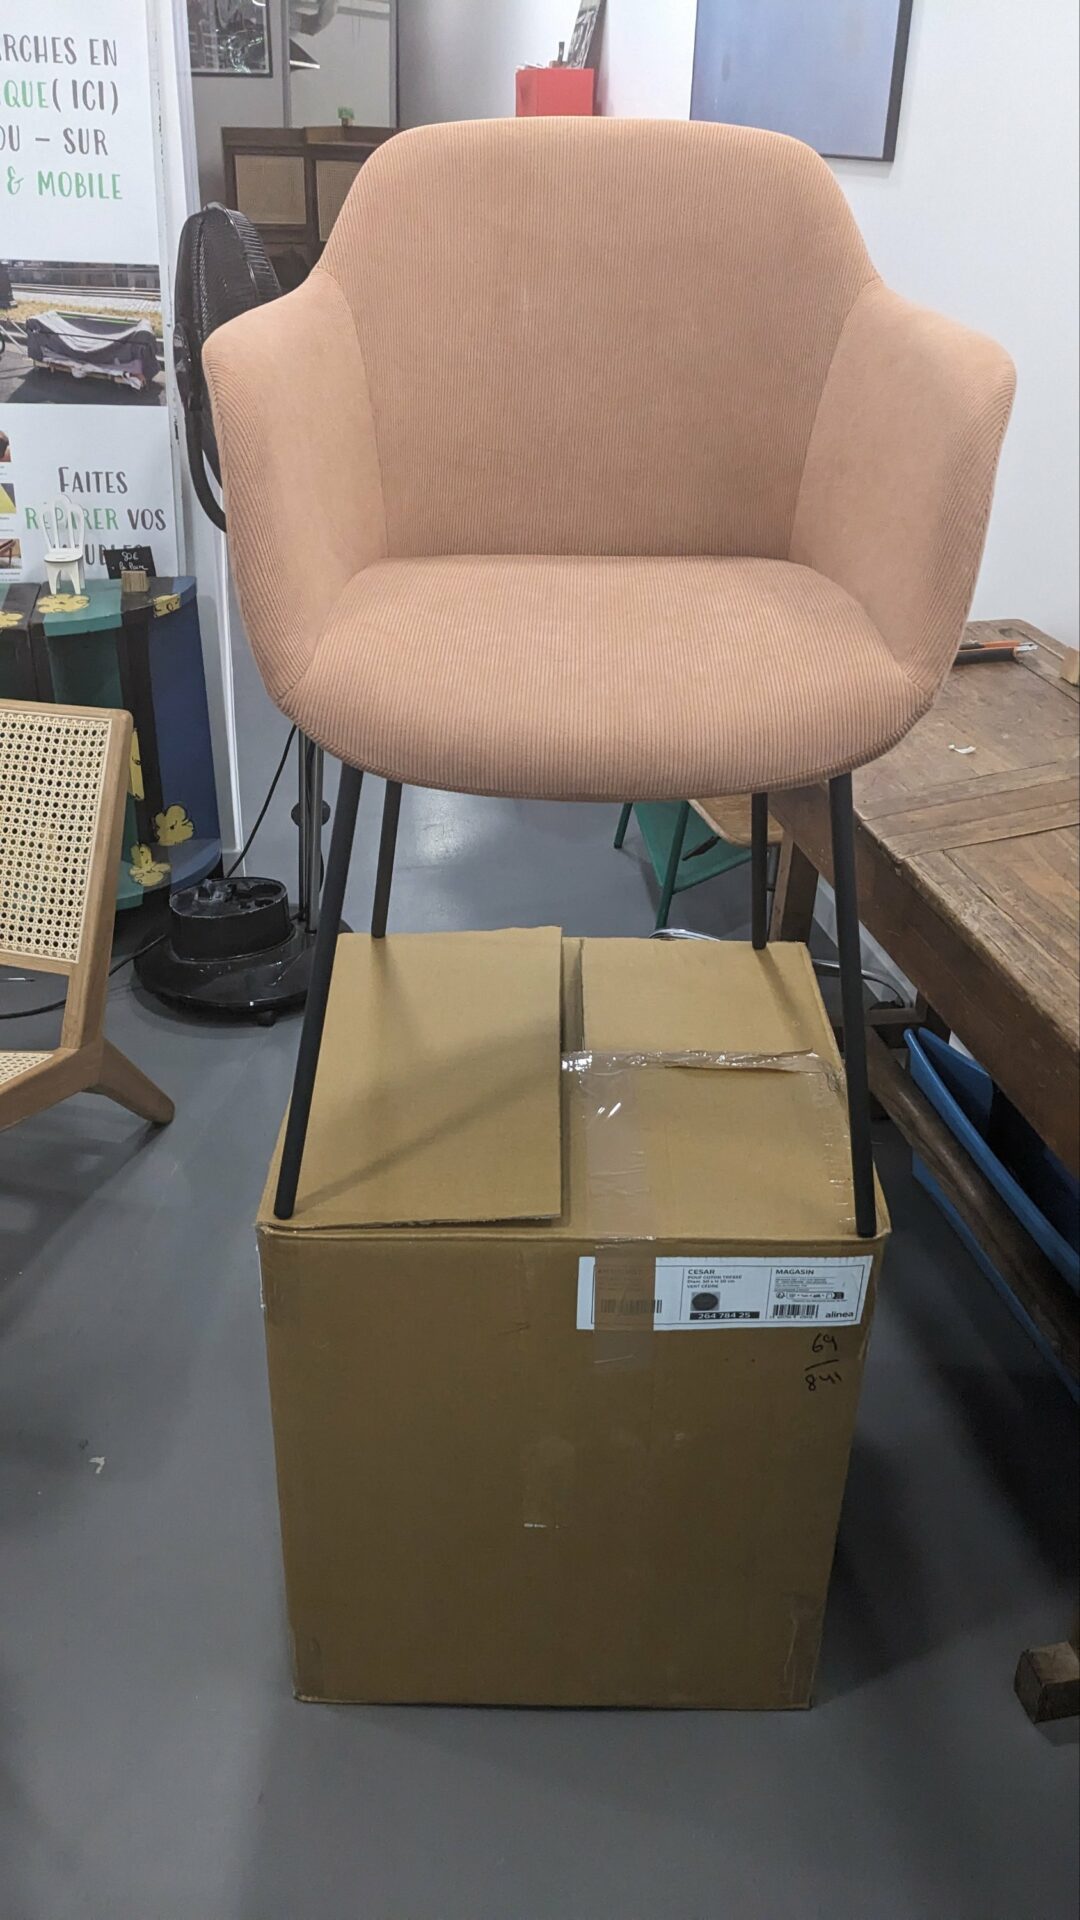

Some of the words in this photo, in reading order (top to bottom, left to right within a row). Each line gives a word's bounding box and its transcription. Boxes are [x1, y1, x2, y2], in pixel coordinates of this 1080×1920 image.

[0, 34, 77, 65] RCHES
[89, 38, 118, 67] EN
[63, 127, 108, 156] SUR
[7, 166, 24, 196] &
[38, 170, 123, 200] MOBILE
[127, 508, 166, 531] VOS
[825, 1311, 854, 1319] alinea
